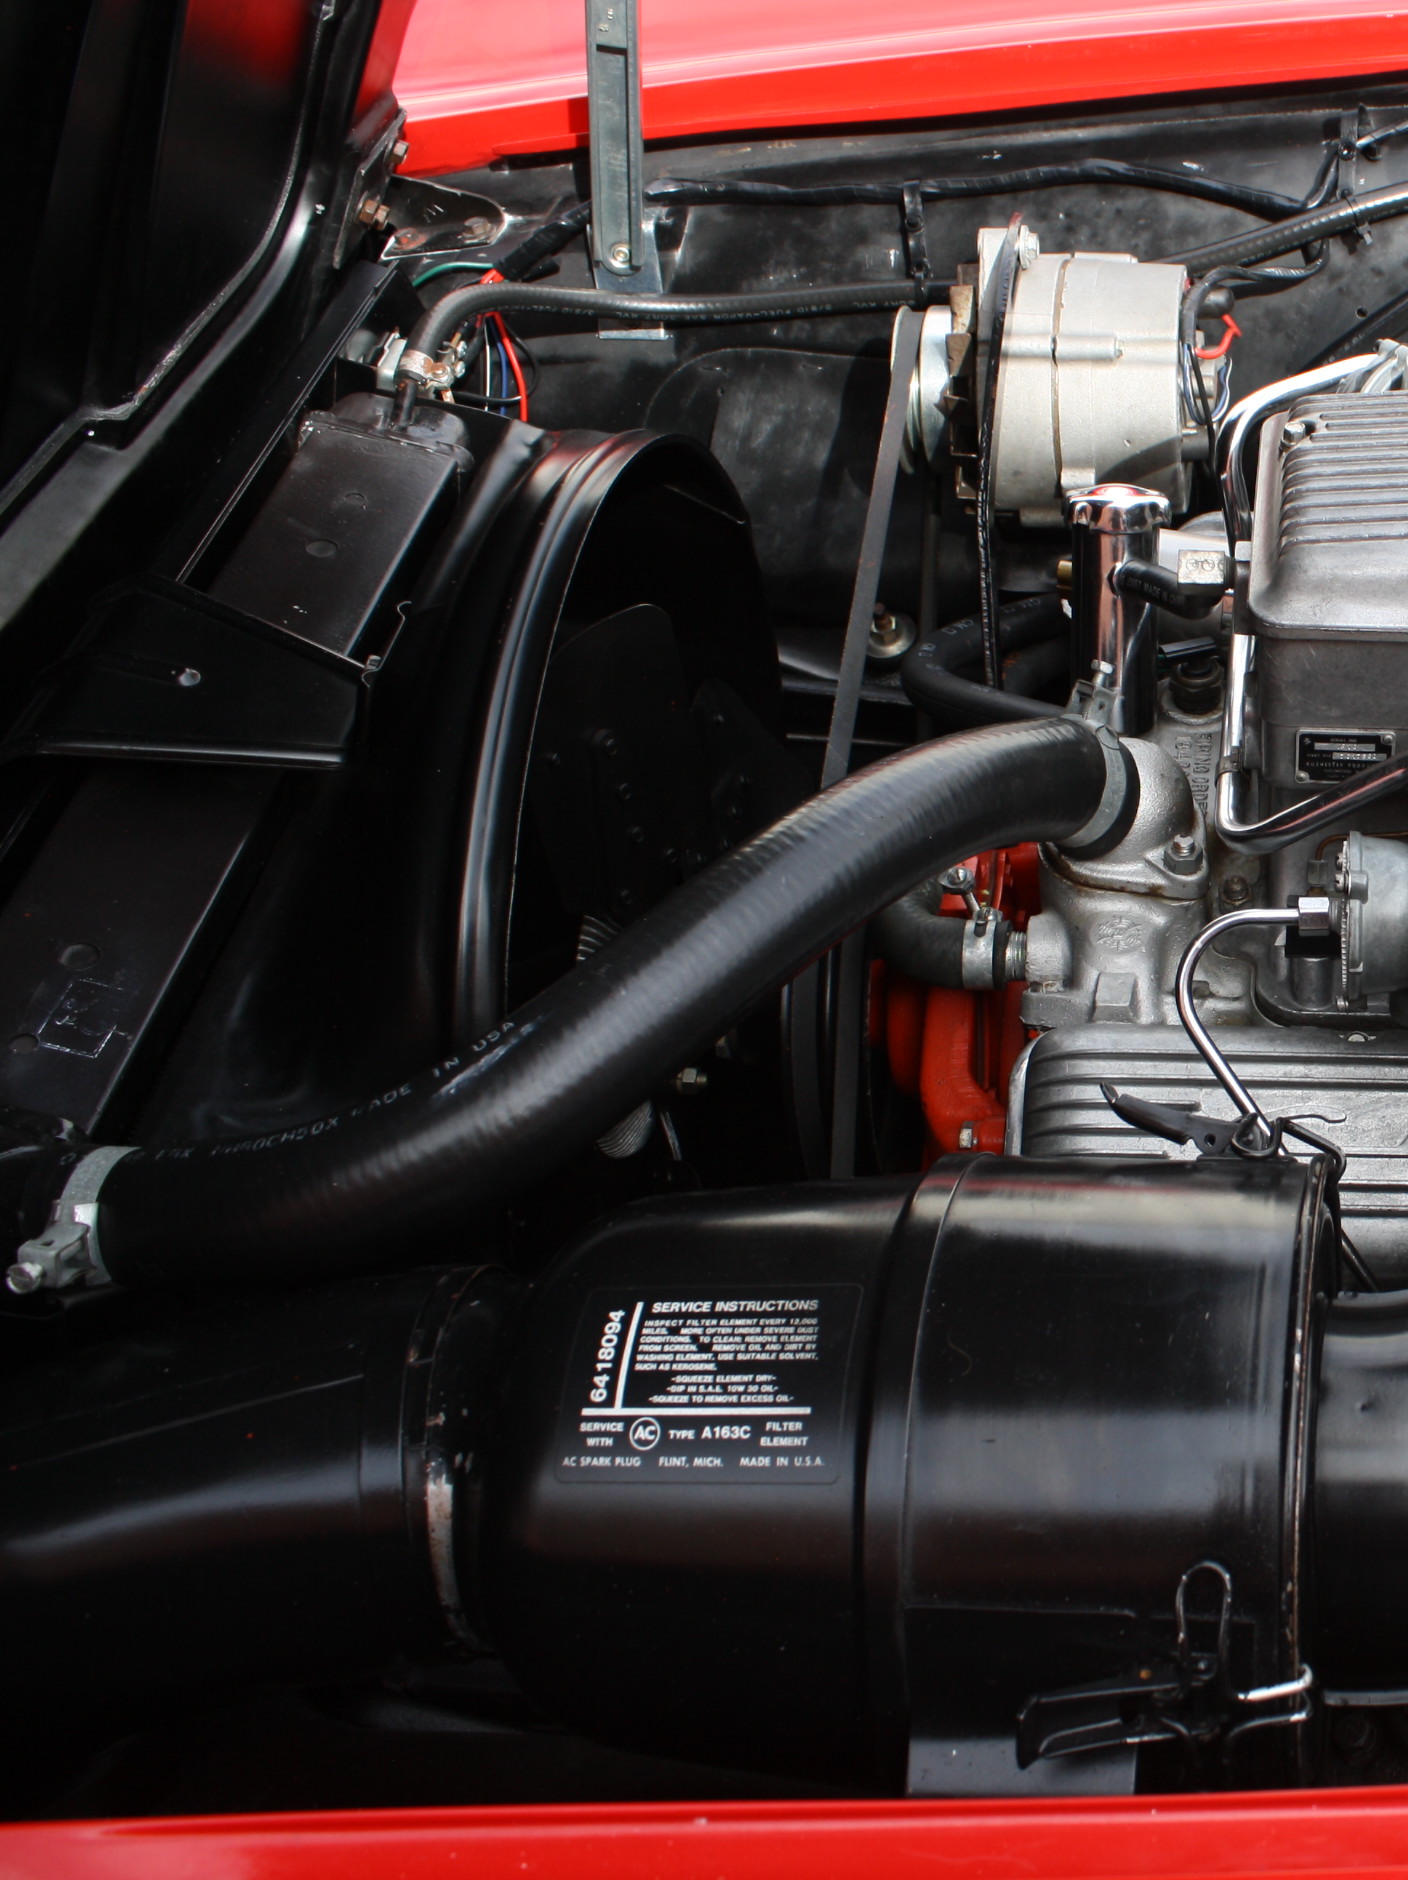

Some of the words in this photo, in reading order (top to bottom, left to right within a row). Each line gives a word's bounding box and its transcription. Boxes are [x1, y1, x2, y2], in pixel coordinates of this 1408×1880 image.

[1193, 732, 1213, 774] FIRING
[1191, 775, 1210, 817] ORDE
[432, 1056, 460, 1078] IN
[472, 1021, 515, 1052] USA
[651, 1301, 712, 1313] SERVICE
[714, 1300, 819, 1312] INSTRUCTIONS
[644, 1319, 684, 1327] INSPECT
[719, 1318, 758, 1326] ELEMENT
[759, 1318, 787, 1326] EVERY
[680, 1327, 704, 1335] MORE
[705, 1327, 733, 1335] OFTEN
[640, 1335, 692, 1343] CONDITIONS.
[744, 1335, 778, 1343] REMOVE
[780, 1335, 818, 1343] ELEMENT
[638, 1344, 662, 1352] FROM
[711, 1344, 747, 1352] REMOVE
[783, 1343, 803, 1351] DIRT
[590, 1309, 626, 1403] 6418094
[636, 1353, 674, 1361] WASHING
[717, 1352, 735, 1360] USE
[736, 1352, 777, 1360] SUITABLE
[634, 1362, 658, 1371] SUCH
[658, 1362, 671, 1371] AS
[715, 1374, 755, 1383] ELEMENT
[727, 1384, 745, 1392] 10W
[691, 1394, 704, 1403] TO
[704, 1394, 740, 1403] REMOVE
[740, 1394, 775, 1402] EXCESS
[579, 1422, 625, 1432] SERVICE
[765, 1421, 803, 1432] FILTER
[633, 1425, 657, 1440] AC
[668, 1430, 696, 1440] TYPE
[701, 1425, 752, 1440] A163C
[586, 1437, 614, 1447] WITH
[760, 1436, 809, 1447] ELEMENT
[562, 1456, 577, 1467] AC
[579, 1456, 613, 1467] SPARK
[614, 1456, 642, 1467] PLUG
[658, 1456, 690, 1468] FLINT,
[692, 1456, 724, 1468] MICH.
[739, 1456, 772, 1467] MADE
[776, 1456, 789, 1467] IN
[794, 1455, 825, 1467] U.S.A.
